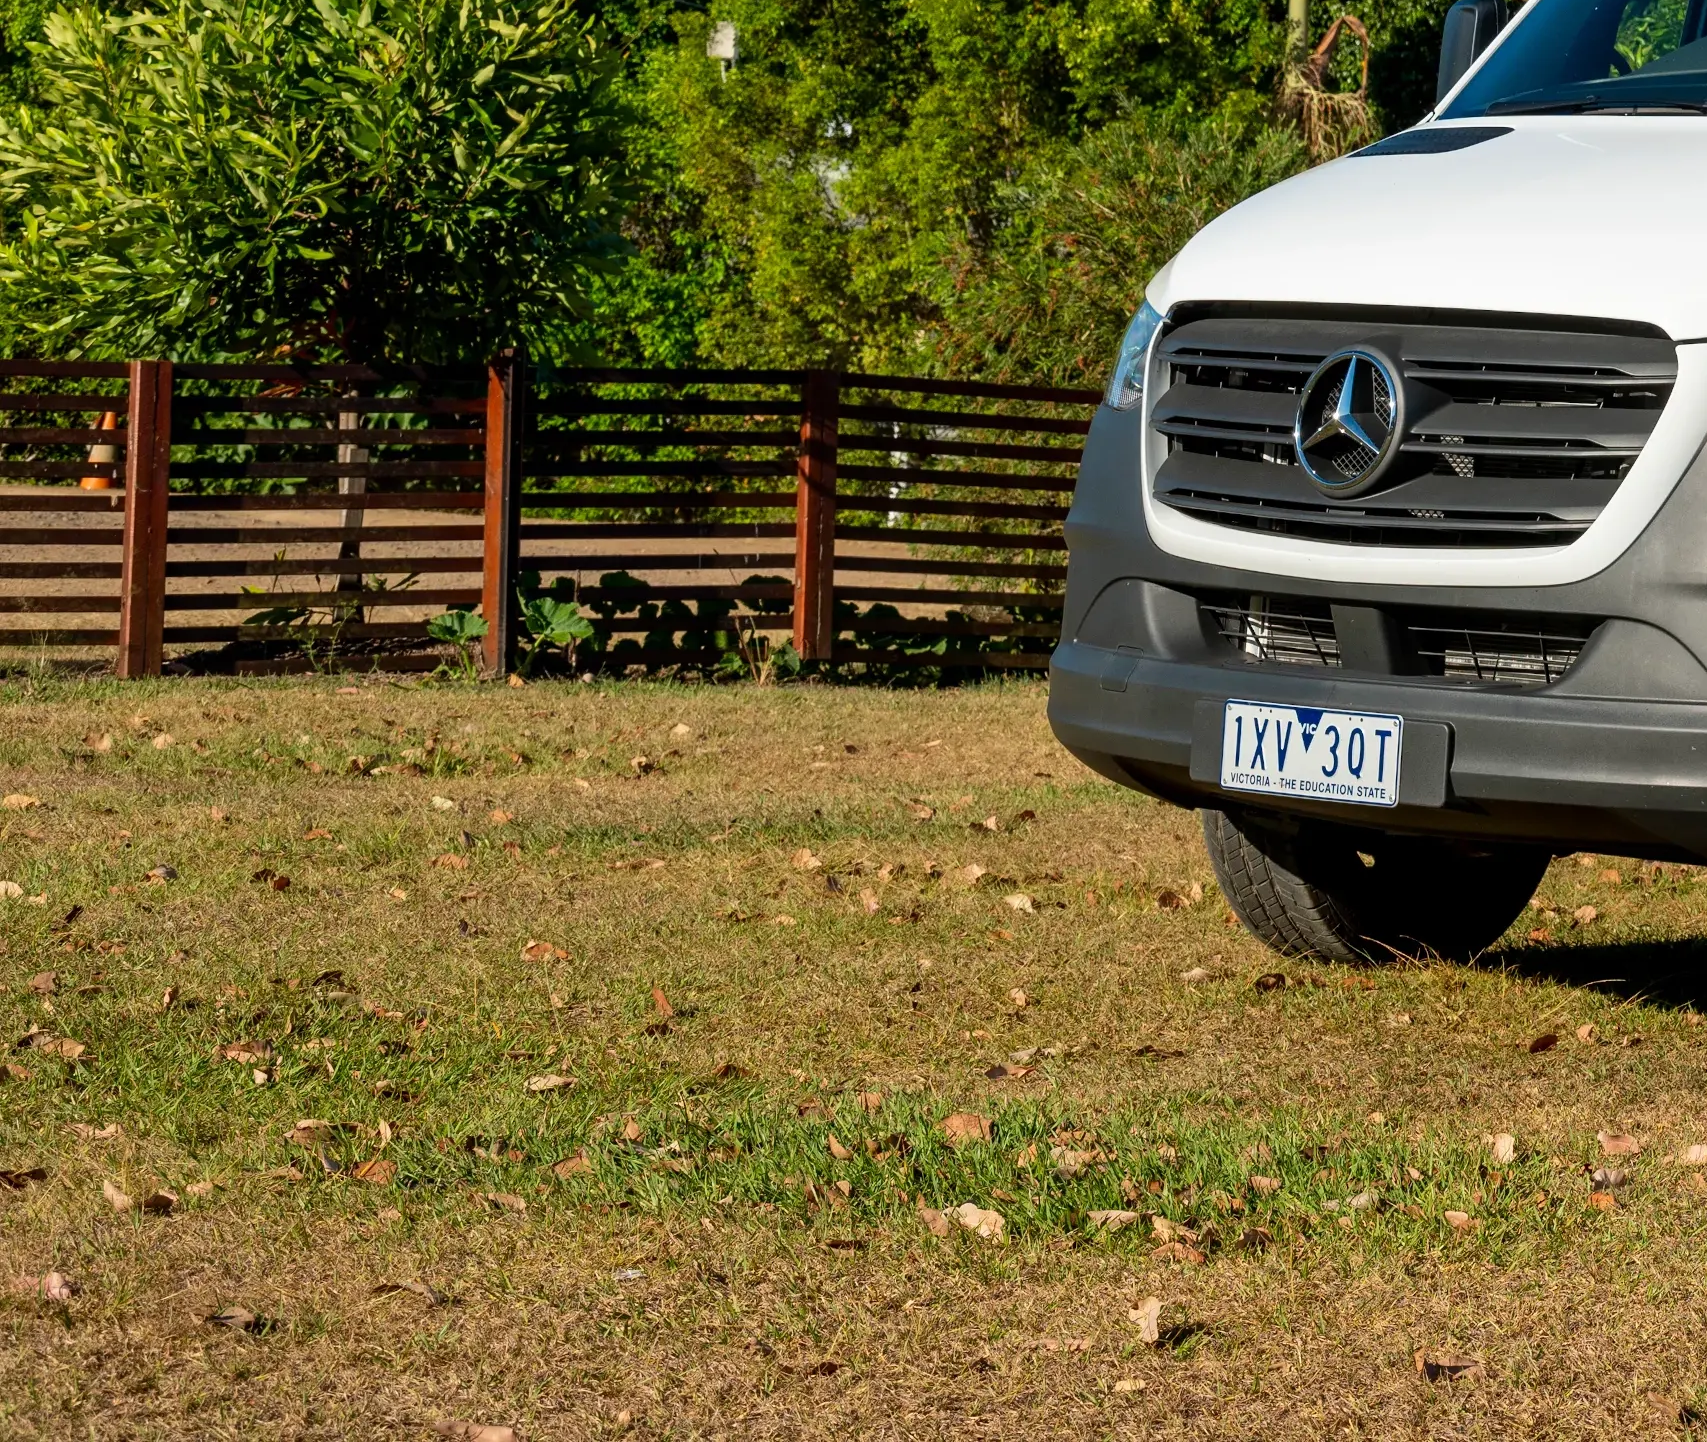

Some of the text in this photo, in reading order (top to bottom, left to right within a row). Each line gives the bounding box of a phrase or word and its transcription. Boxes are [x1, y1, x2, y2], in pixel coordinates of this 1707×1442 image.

[1300, 722, 1317, 735] VIC
[1235, 715, 1392, 783] 1XV 3QT
[1230, 772, 1271, 787] VICTORIA
[1279, 777, 1297, 790] THE
[1299, 779, 1354, 796] EDUCATION
[1356, 786, 1386, 800] STATE
